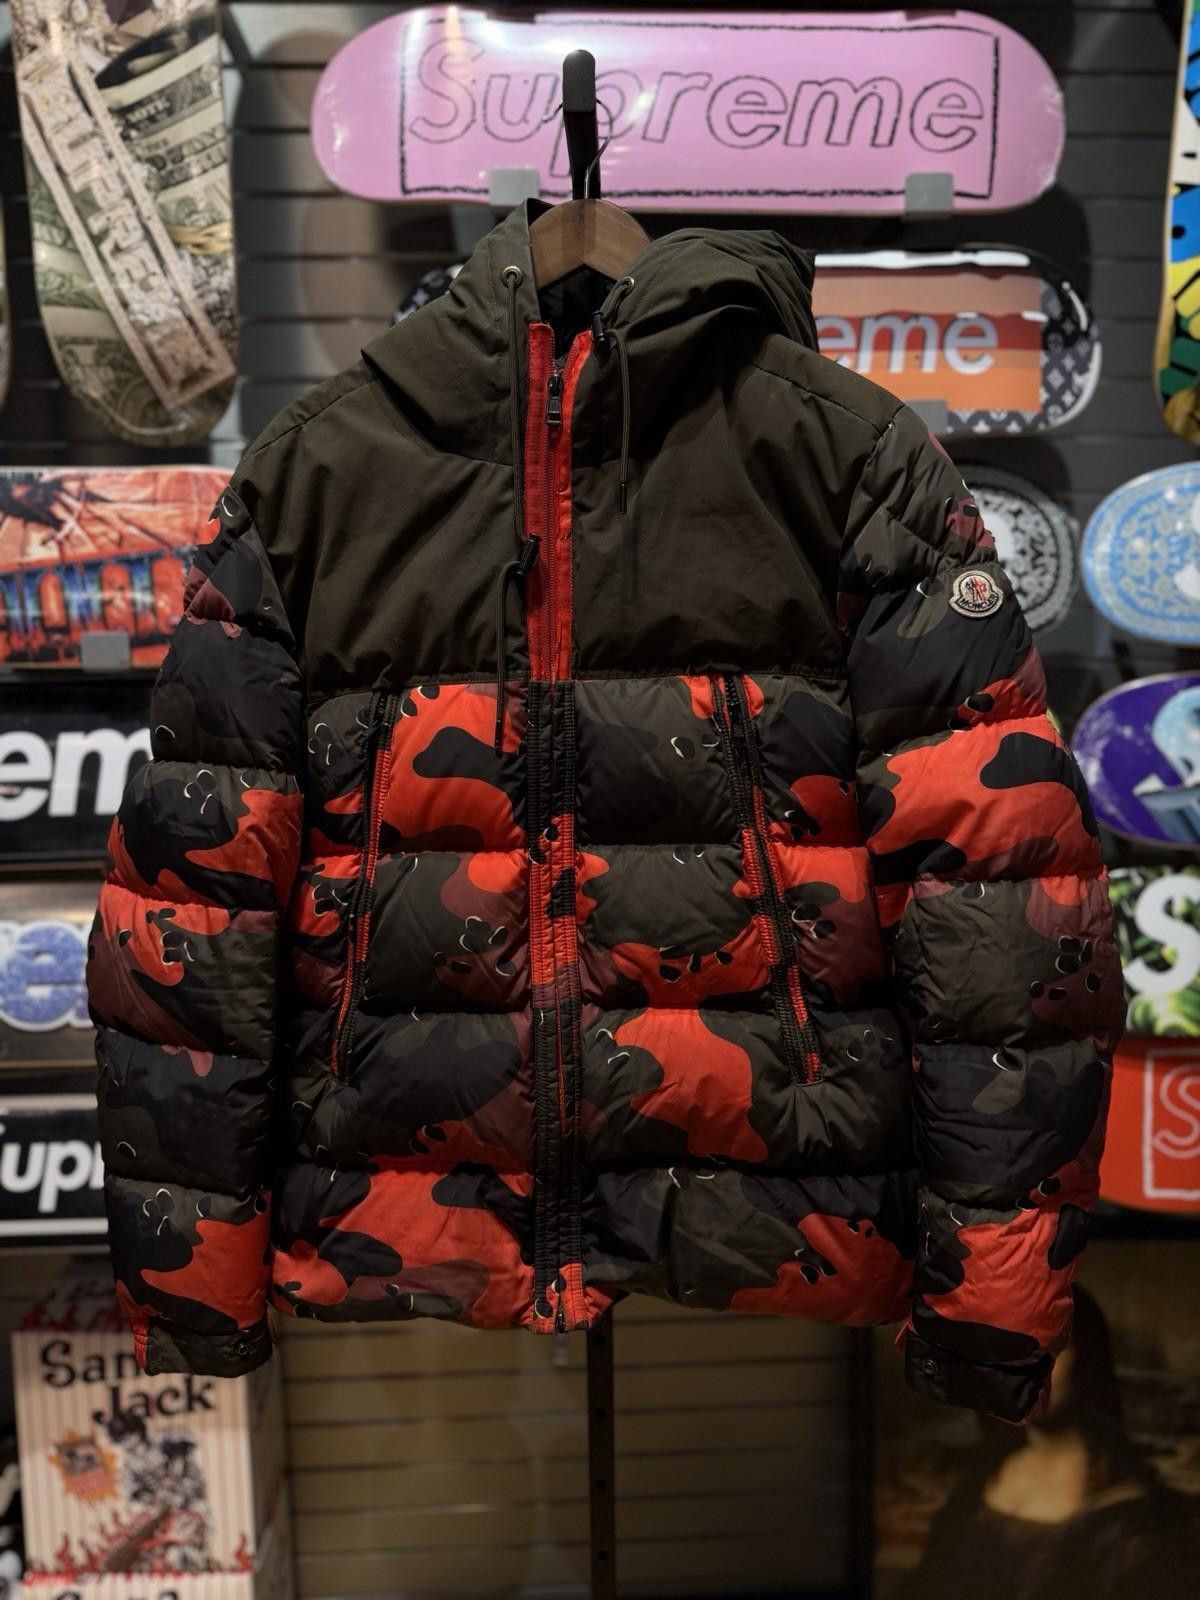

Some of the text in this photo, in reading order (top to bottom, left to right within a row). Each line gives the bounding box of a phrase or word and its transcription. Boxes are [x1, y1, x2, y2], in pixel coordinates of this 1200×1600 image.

[408, 37, 985, 179] Supreme
[958, 593, 999, 610] MONCLER
[92, 1373, 216, 1425] Jack
